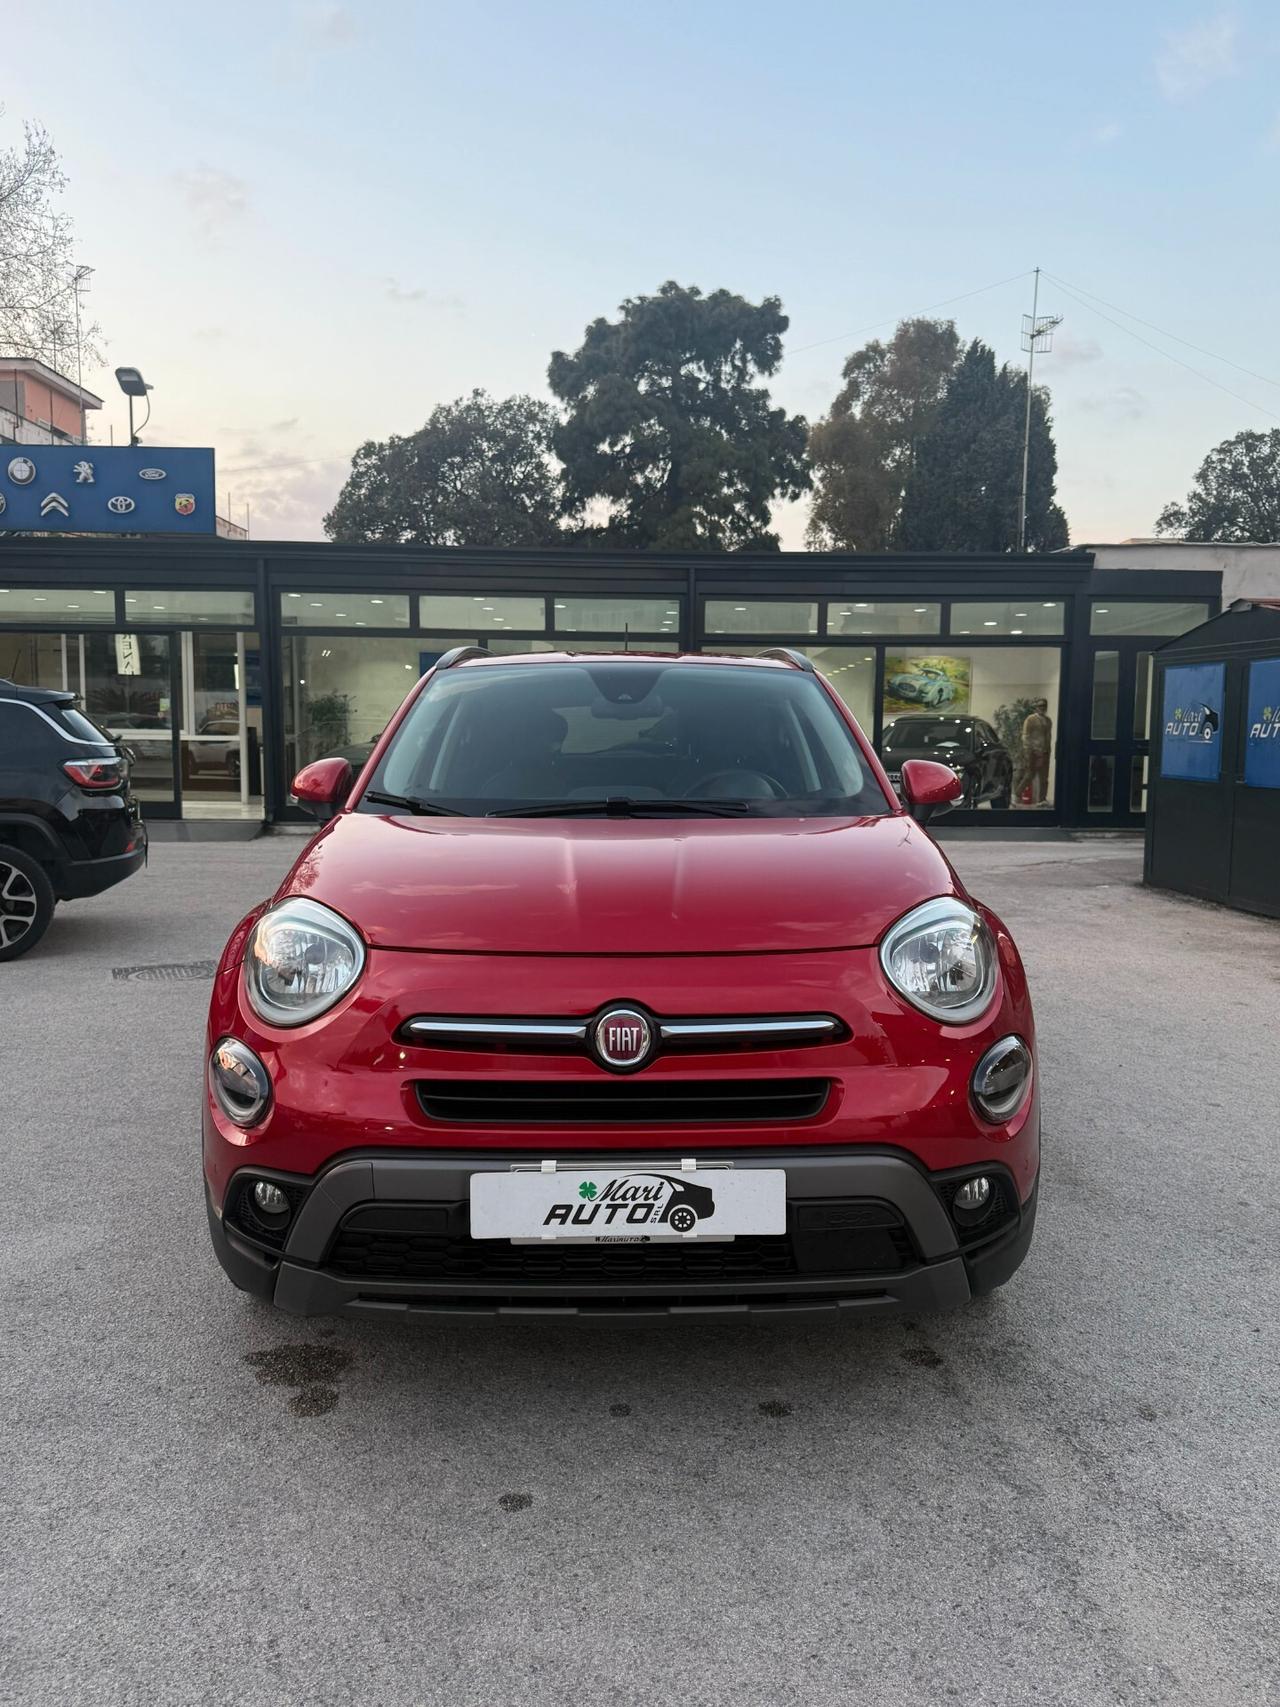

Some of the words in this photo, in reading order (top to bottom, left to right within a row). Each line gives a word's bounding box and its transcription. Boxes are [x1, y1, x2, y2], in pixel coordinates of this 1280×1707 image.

[1165, 722, 1199, 736] AUTO
[608, 1027, 640, 1052] FIAT
[588, 1179, 665, 1202] Mari
[542, 1203, 655, 1226] AUTO
[650, 1203, 664, 1224] SRL
